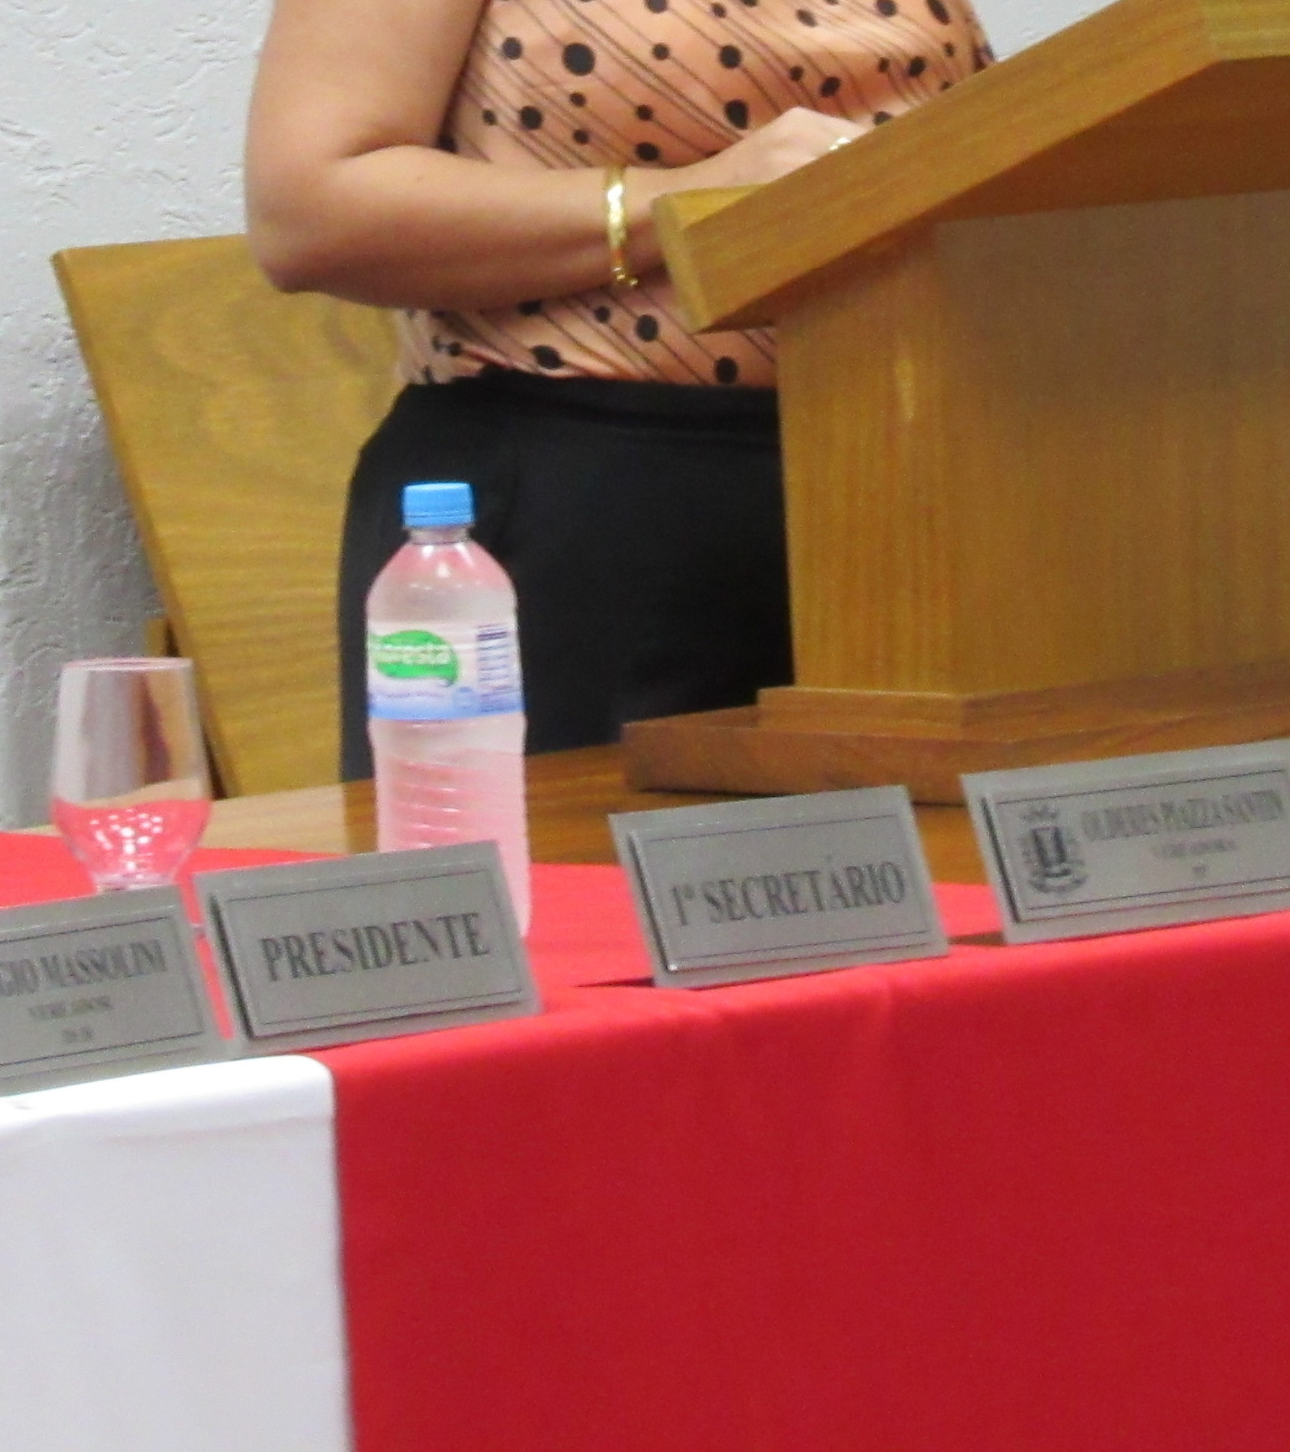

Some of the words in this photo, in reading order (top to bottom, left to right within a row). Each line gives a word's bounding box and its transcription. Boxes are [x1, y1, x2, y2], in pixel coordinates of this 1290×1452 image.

[701, 853, 906, 924] SECRETÁRIO
[39, 938, 168, 988] MASSOLINI
[260, 912, 490, 982] PRESIDENTE
